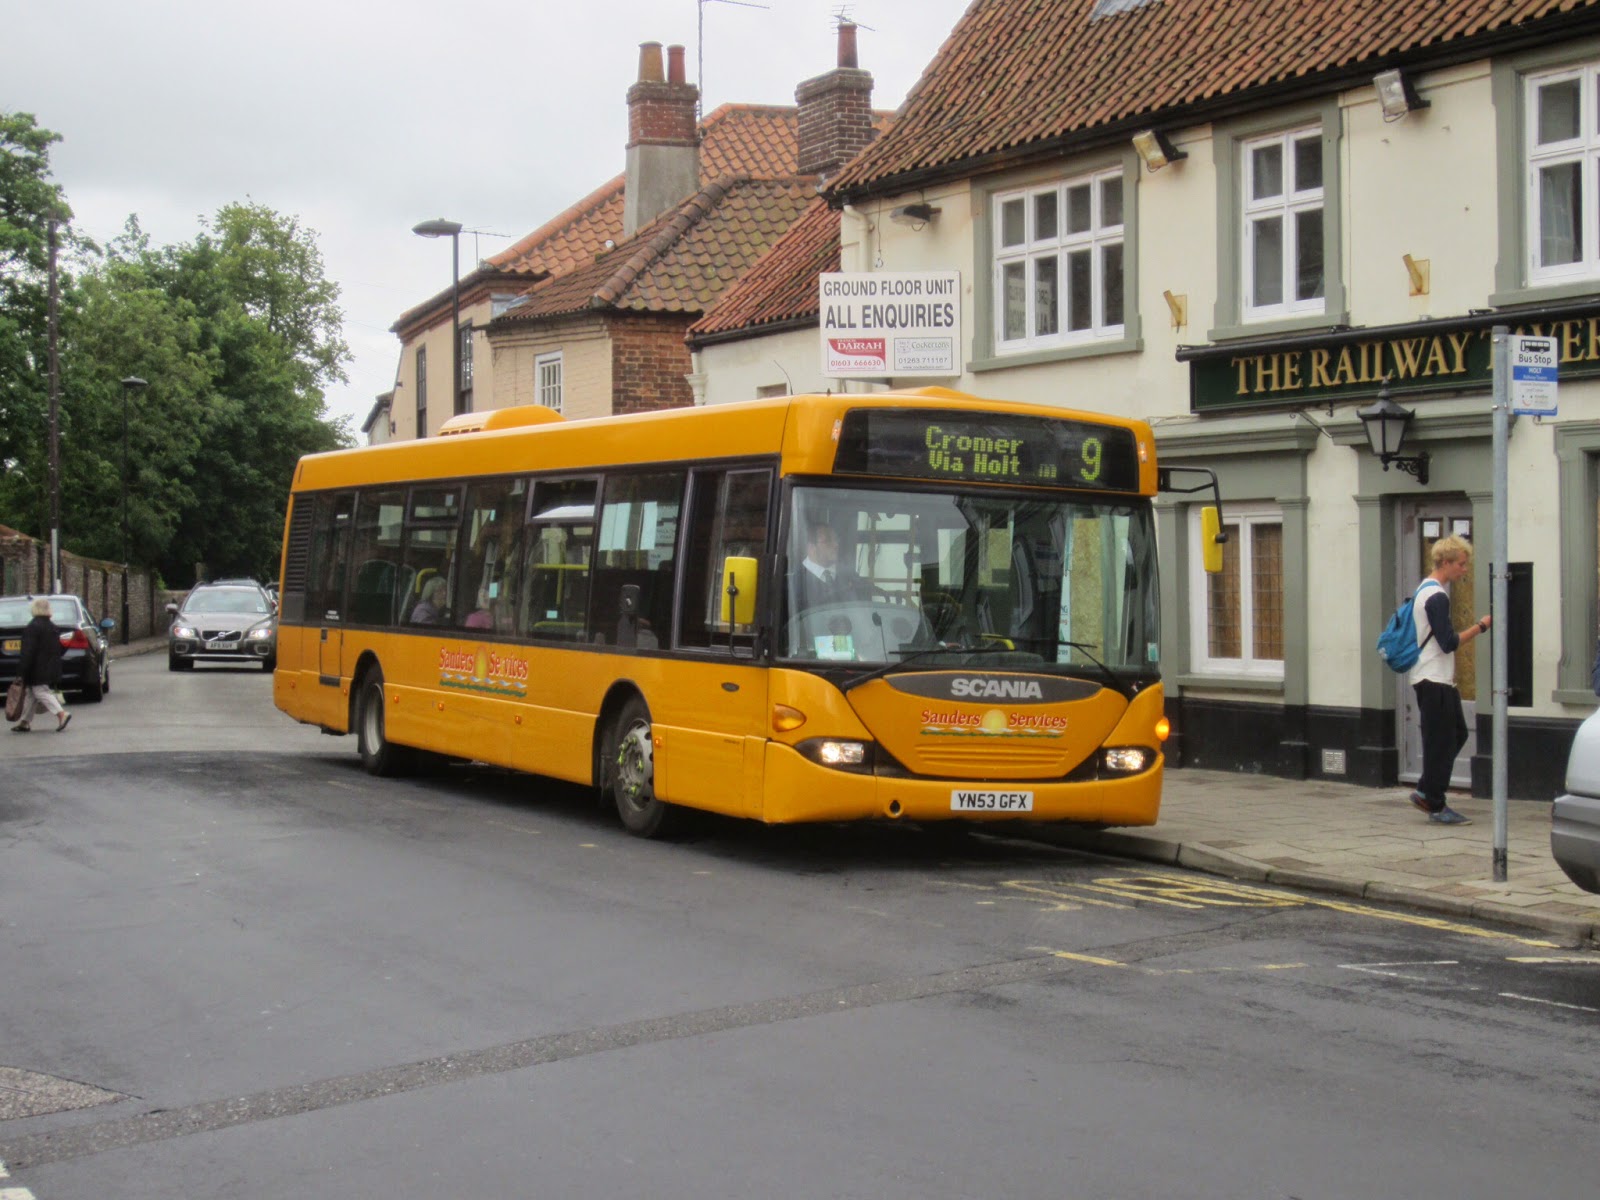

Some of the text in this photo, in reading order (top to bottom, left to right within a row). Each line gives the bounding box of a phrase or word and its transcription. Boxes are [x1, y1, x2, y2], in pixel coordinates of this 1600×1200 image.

[824, 279, 954, 296] GROUND FLOOR UNIT
[825, 303, 954, 329] ALL ENQUIRIES
[837, 342, 882, 350] DARRAH
[1231, 351, 1304, 395] THE
[1309, 331, 1474, 387] RAILWAY
[1519, 354, 1552, 365] Bus Stop
[925, 425, 1024, 455] Cromer
[928, 450, 964, 472] Via
[973, 453, 1021, 476] Holt
[1081, 437, 1102, 481] 9
[439, 646, 474, 673] Sanders
[951, 678, 1043, 699] SCANIA
[920, 709, 1068, 728] Sanders Services
[958, 793, 1027, 809] YN53 GFX
